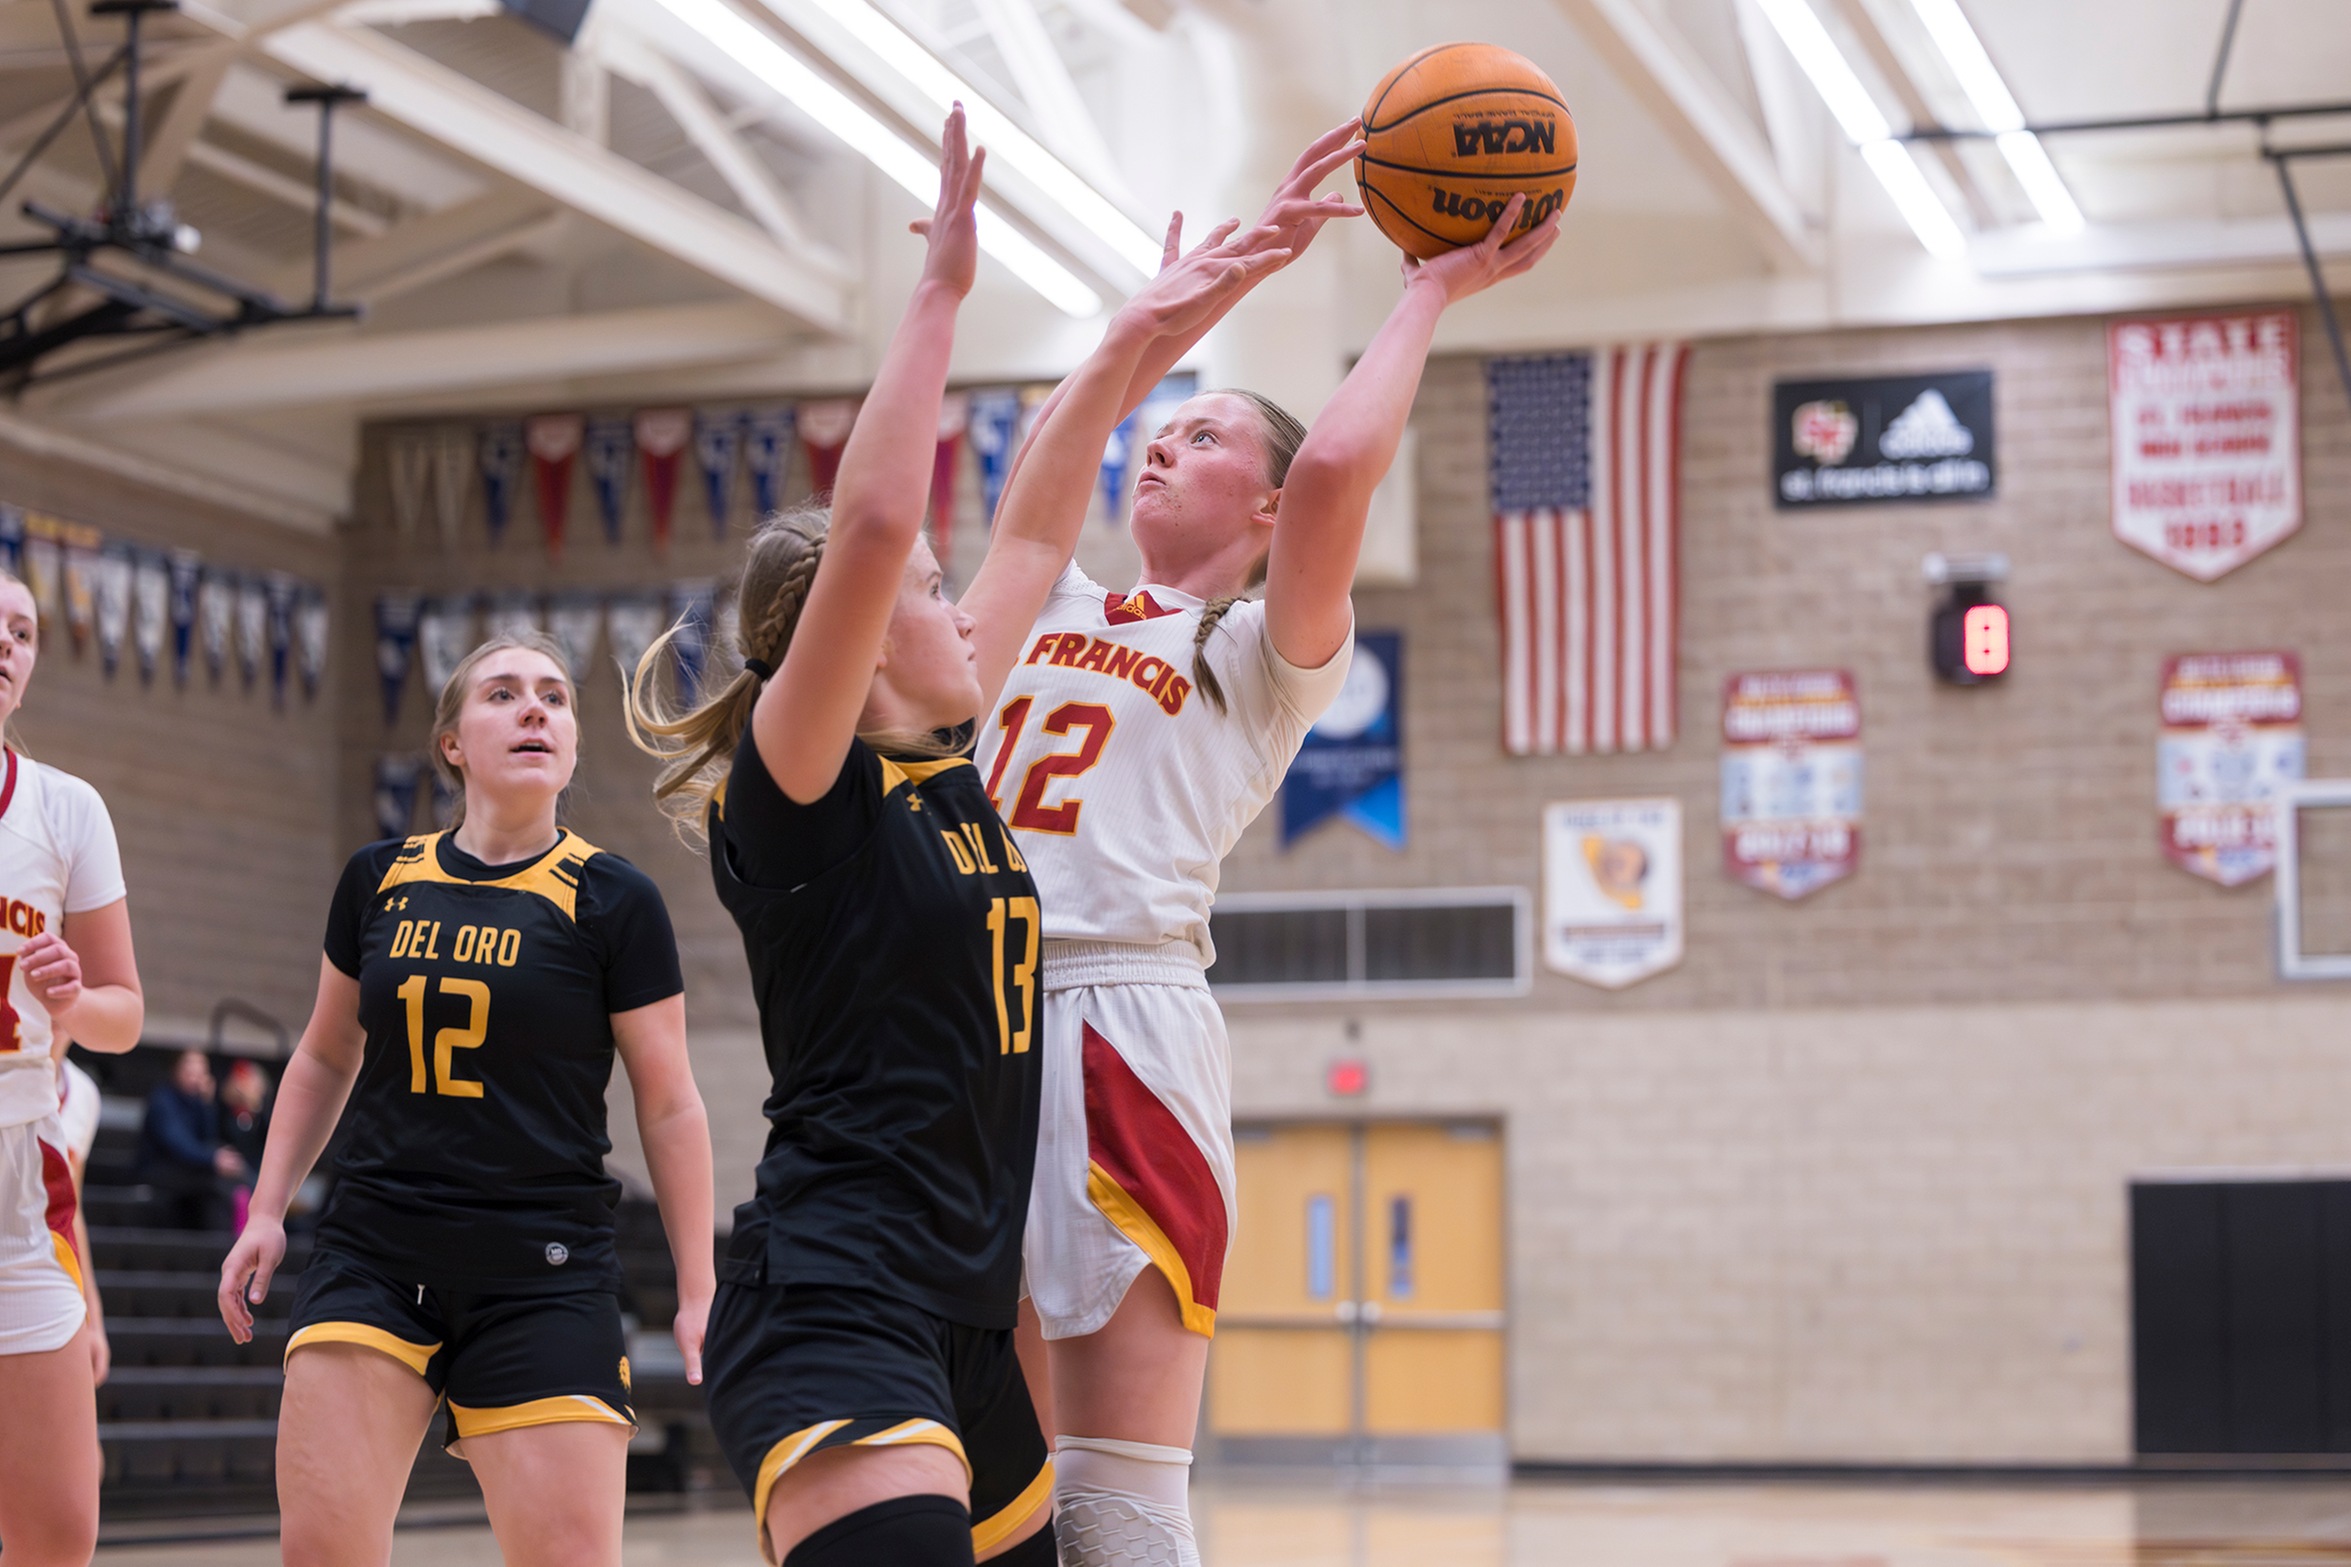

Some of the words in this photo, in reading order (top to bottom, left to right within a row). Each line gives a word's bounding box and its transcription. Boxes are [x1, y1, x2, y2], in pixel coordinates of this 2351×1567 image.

[1454, 121, 1555, 157] NCAA
[1432, 186, 1564, 232] Wison
[1023, 632, 1194, 717] FRANCIS
[1964, 604, 2010, 675] 8
[986, 694, 1117, 837] 12
[389, 920, 441, 960] DEL
[453, 924, 522, 967] ORO
[986, 896, 1040, 1055] 13
[397, 974, 492, 1098] 12
